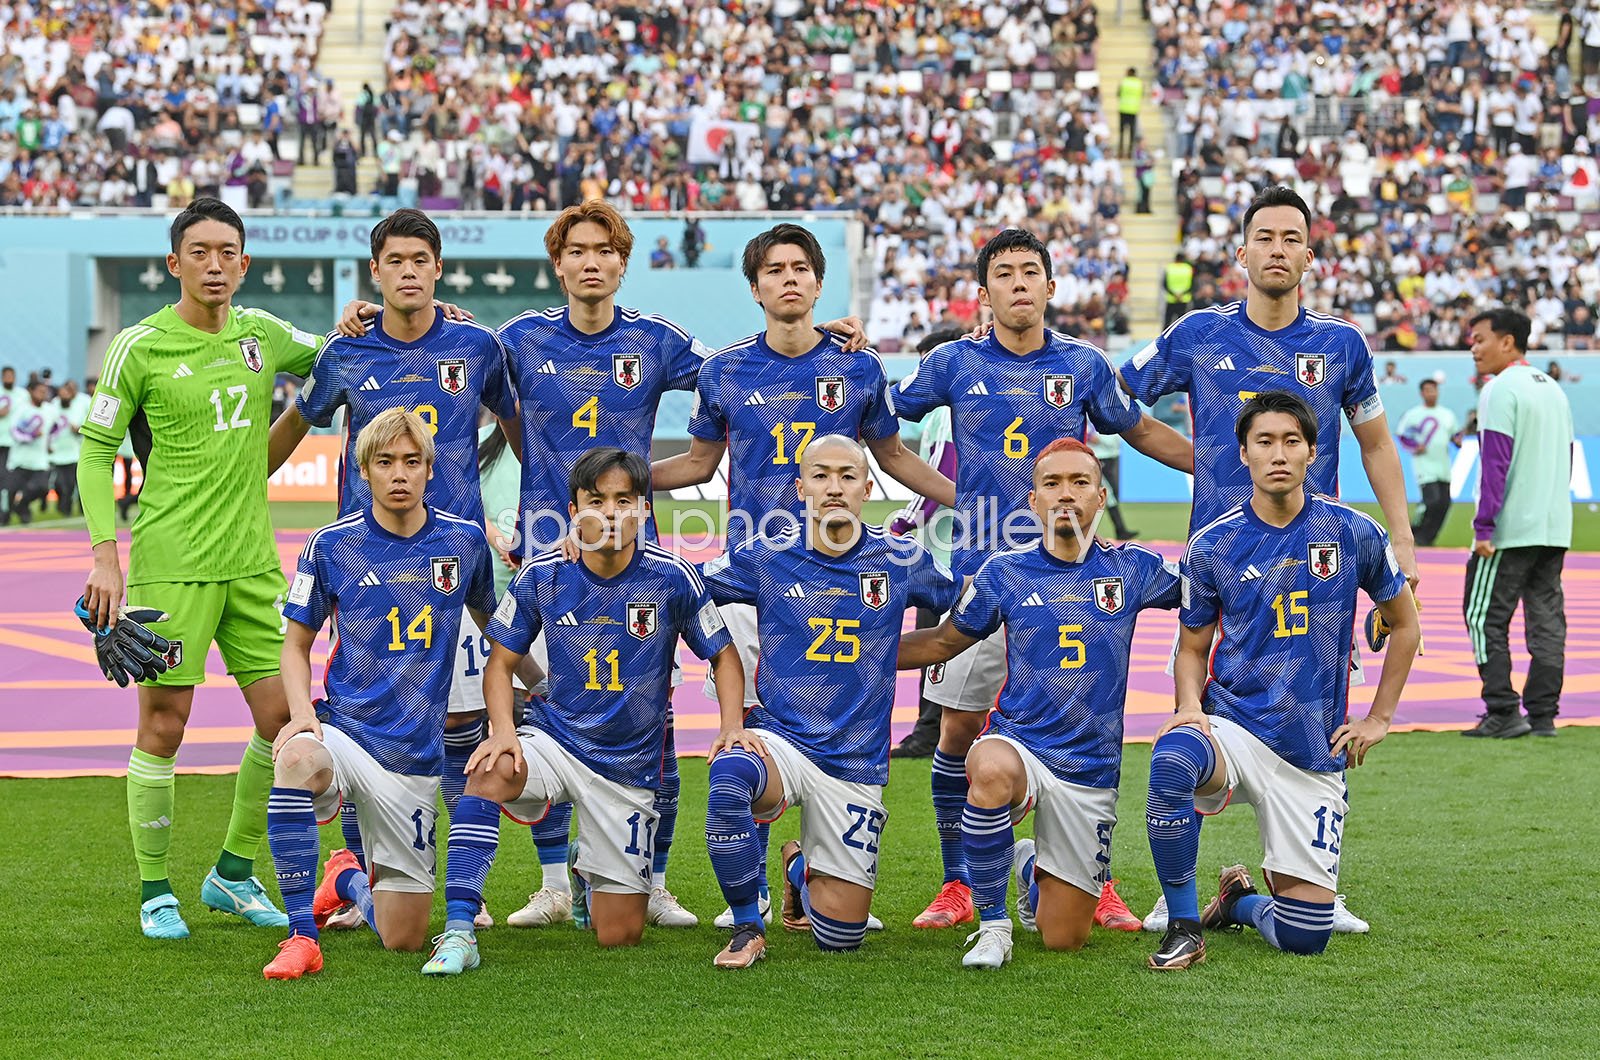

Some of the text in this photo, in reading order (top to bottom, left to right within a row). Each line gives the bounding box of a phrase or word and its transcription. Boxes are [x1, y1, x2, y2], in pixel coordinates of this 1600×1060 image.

[293, 226, 331, 241] CUP
[209, 385, 251, 432] 12
[574, 396, 599, 436] 4
[770, 422, 816, 464] 17
[1004, 417, 1029, 459] 6
[387, 605, 433, 651] 14
[1273, 590, 1309, 638] 15
[805, 617, 861, 663] 25
[1058, 625, 1086, 669] 5
[583, 648, 624, 692] 11
[625, 812, 656, 859] 11
[842, 803, 883, 854] 25
